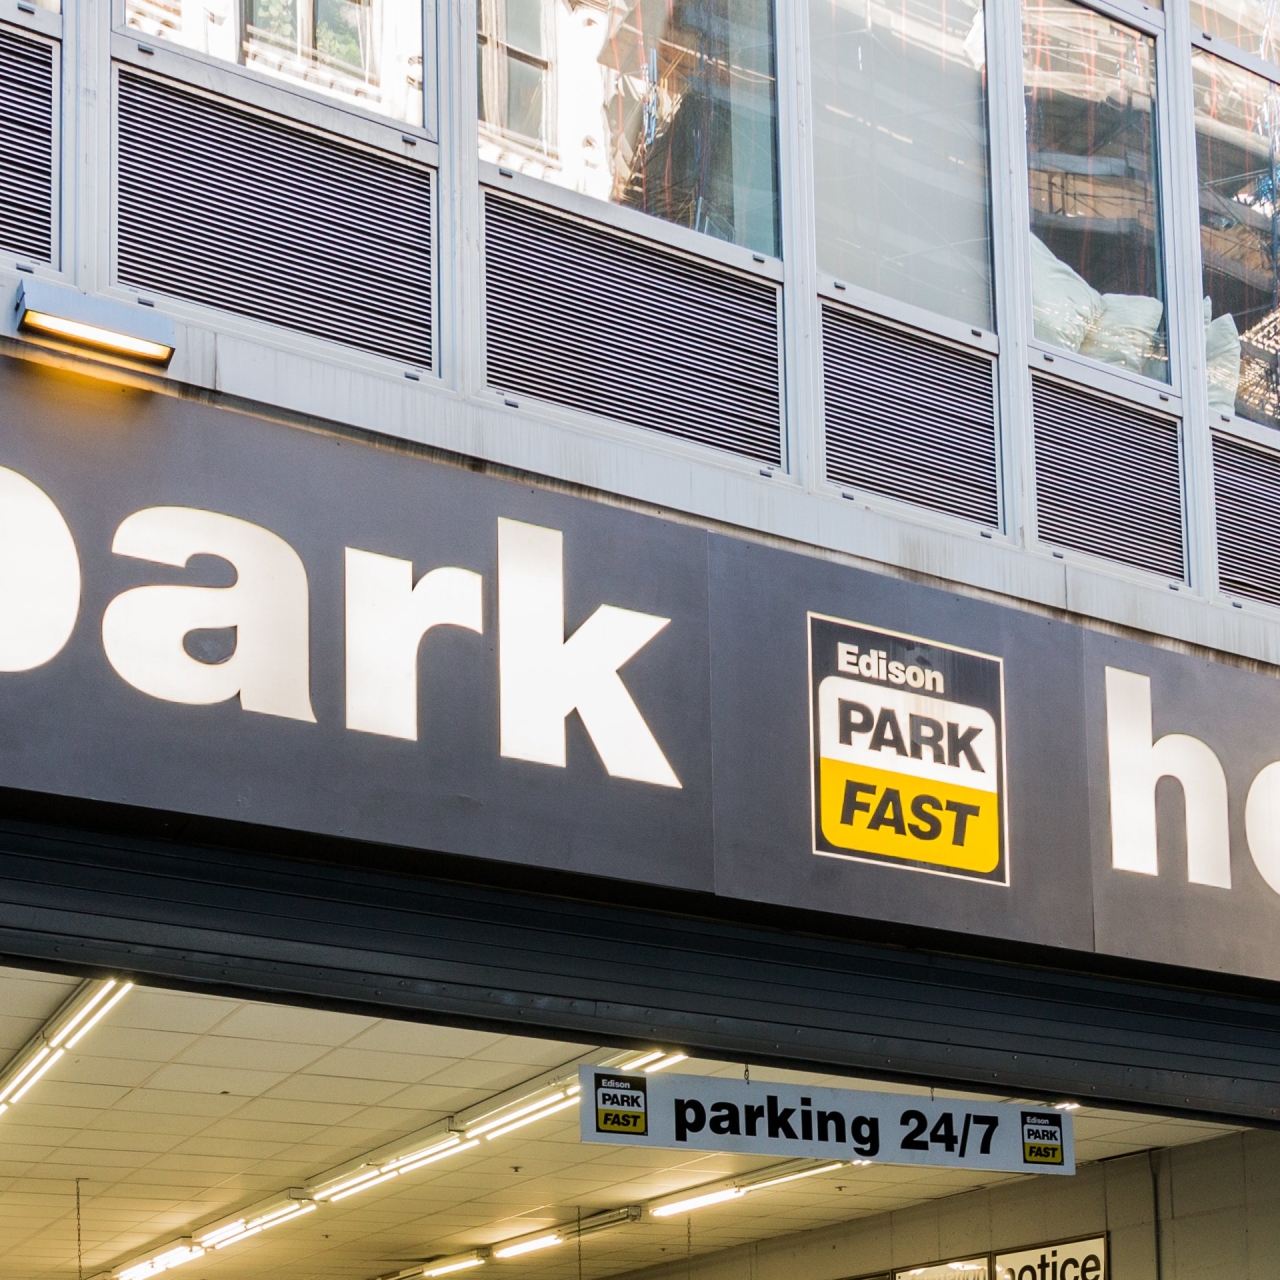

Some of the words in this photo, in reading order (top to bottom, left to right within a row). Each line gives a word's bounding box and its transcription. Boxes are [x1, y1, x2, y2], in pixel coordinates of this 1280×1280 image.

[837, 641, 944, 694] Edison
[837, 697, 986, 773] PARK
[839, 779, 980, 847] FAST
[601, 1079, 630, 1089] Edison
[601, 1092, 642, 1108] PARK
[603, 1112, 641, 1127] FAST
[674, 1095, 880, 1157] parking
[899, 1109, 999, 1158] 24/7
[1026, 1116, 1049, 1125] Edison
[1027, 1128, 1059, 1142] PARK
[1028, 1146, 1059, 1158] FAST
